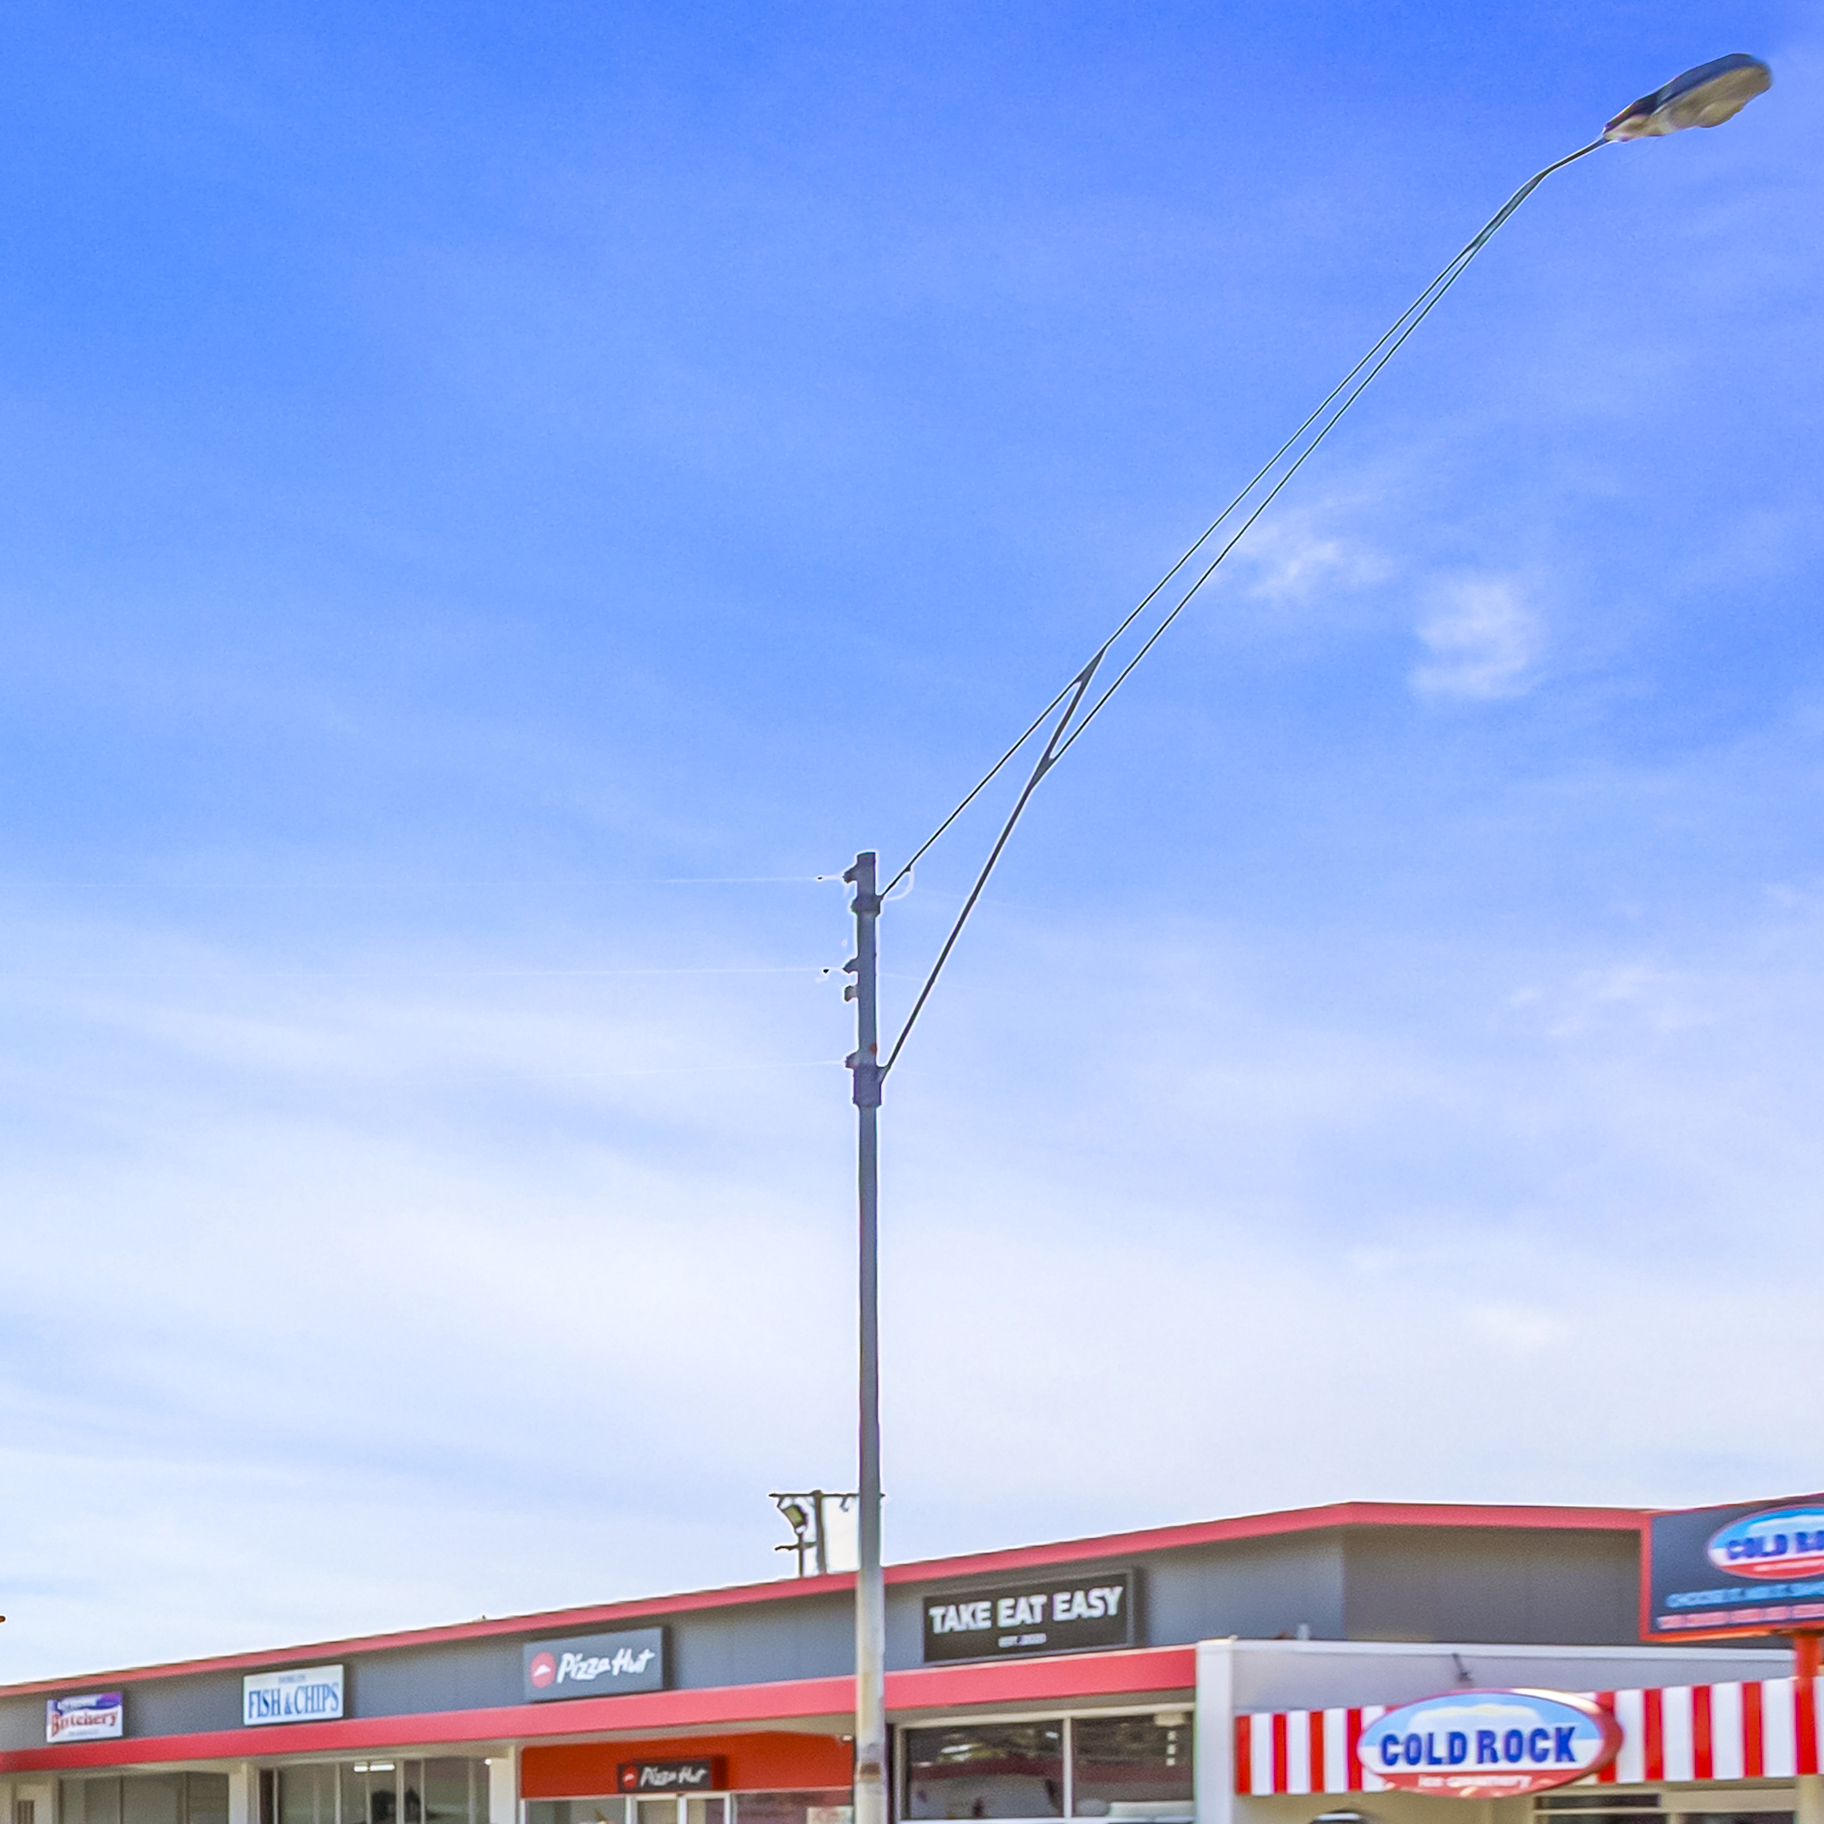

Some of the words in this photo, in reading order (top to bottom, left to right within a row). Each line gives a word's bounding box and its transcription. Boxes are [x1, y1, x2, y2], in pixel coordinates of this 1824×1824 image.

[929, 1601, 992, 1634] TAKE
[997, 1594, 1047, 1627] EAT
[1053, 1586, 1124, 1622] EASY
[557, 1652, 611, 1684] Pizza
[611, 1648, 655, 1676] Hut
[248, 1688, 281, 1719] FISH
[284, 1692, 293, 1714] &
[294, 1682, 340, 1715] CHIPS
[51, 1710, 118, 1738] Butchery
[1380, 1731, 1468, 1767] COLD
[1476, 1726, 1577, 1764] ROCK
